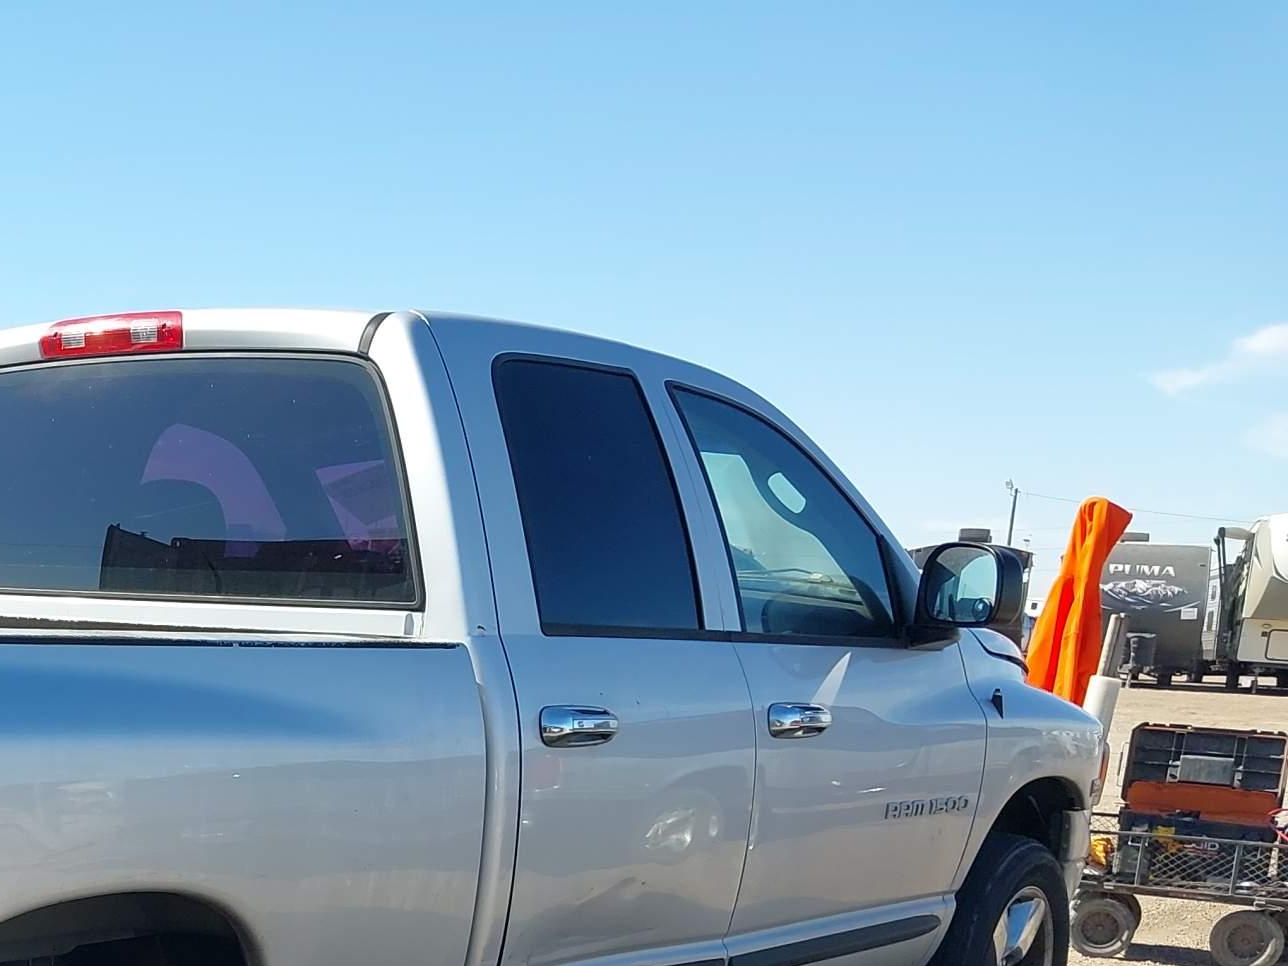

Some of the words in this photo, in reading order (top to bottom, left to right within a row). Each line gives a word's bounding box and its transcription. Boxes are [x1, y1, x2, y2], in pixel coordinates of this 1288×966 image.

[1108, 563, 1176, 577] PUMA
[884, 801, 926, 820] RAM
[927, 795, 969, 816] 1500
